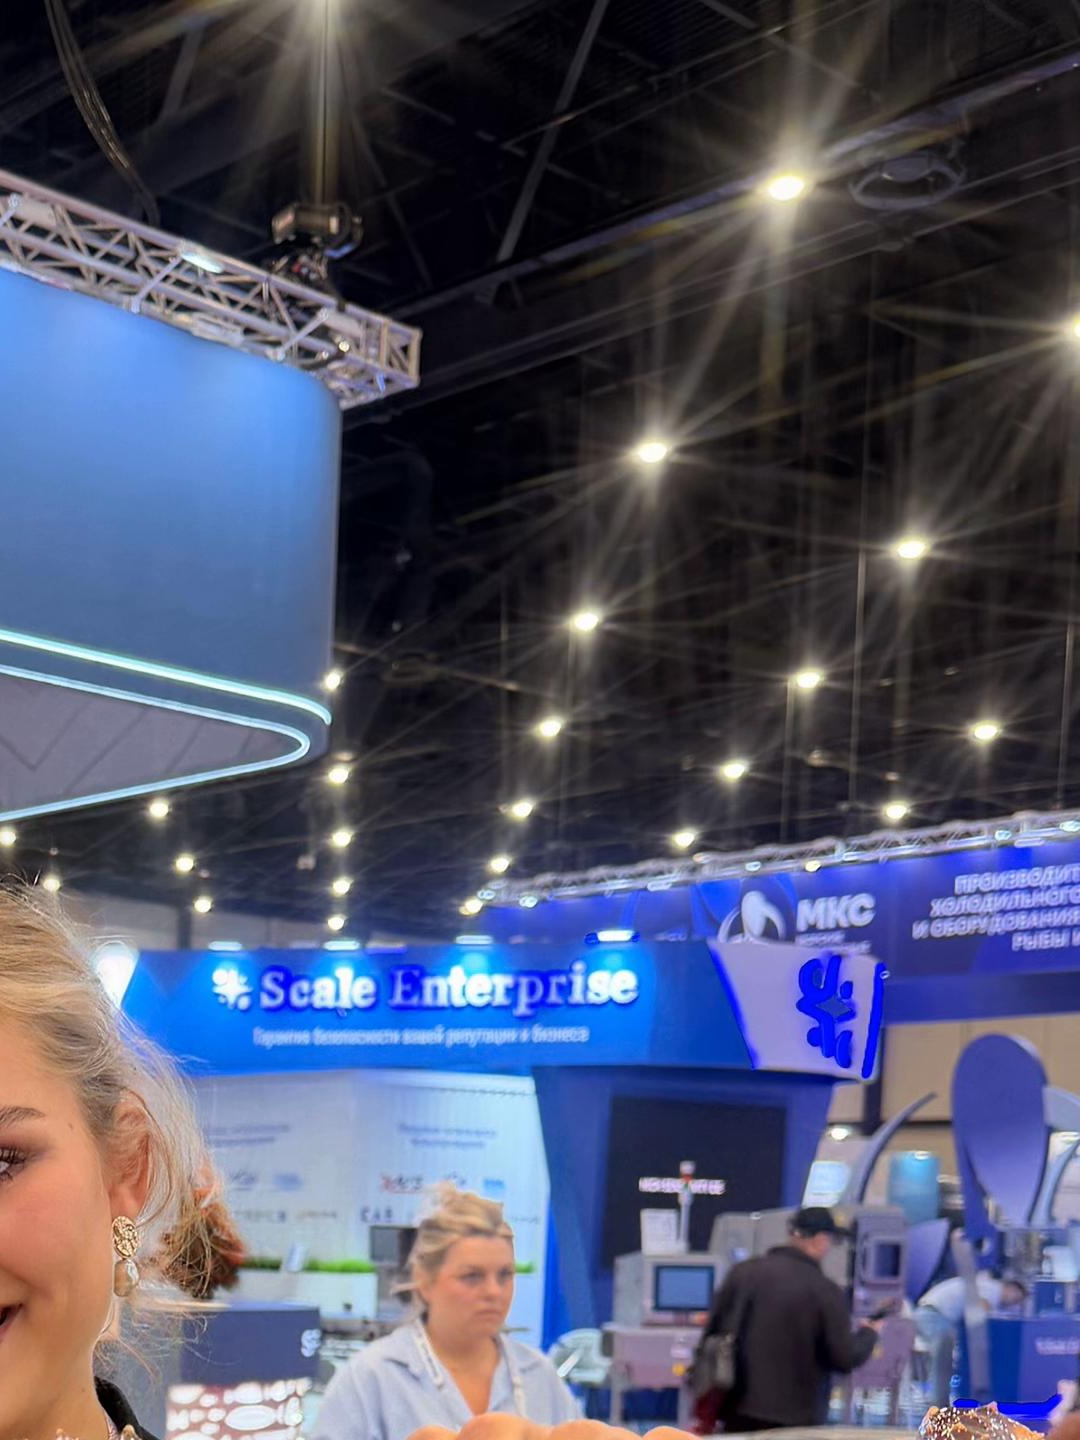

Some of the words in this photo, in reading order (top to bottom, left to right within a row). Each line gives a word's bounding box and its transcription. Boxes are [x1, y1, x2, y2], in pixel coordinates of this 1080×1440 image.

[796, 893, 876, 932] МКС
[912, 919, 929, 940] И
[259, 966, 376, 1010] Scale
[387, 961, 639, 1017] Enterprise
